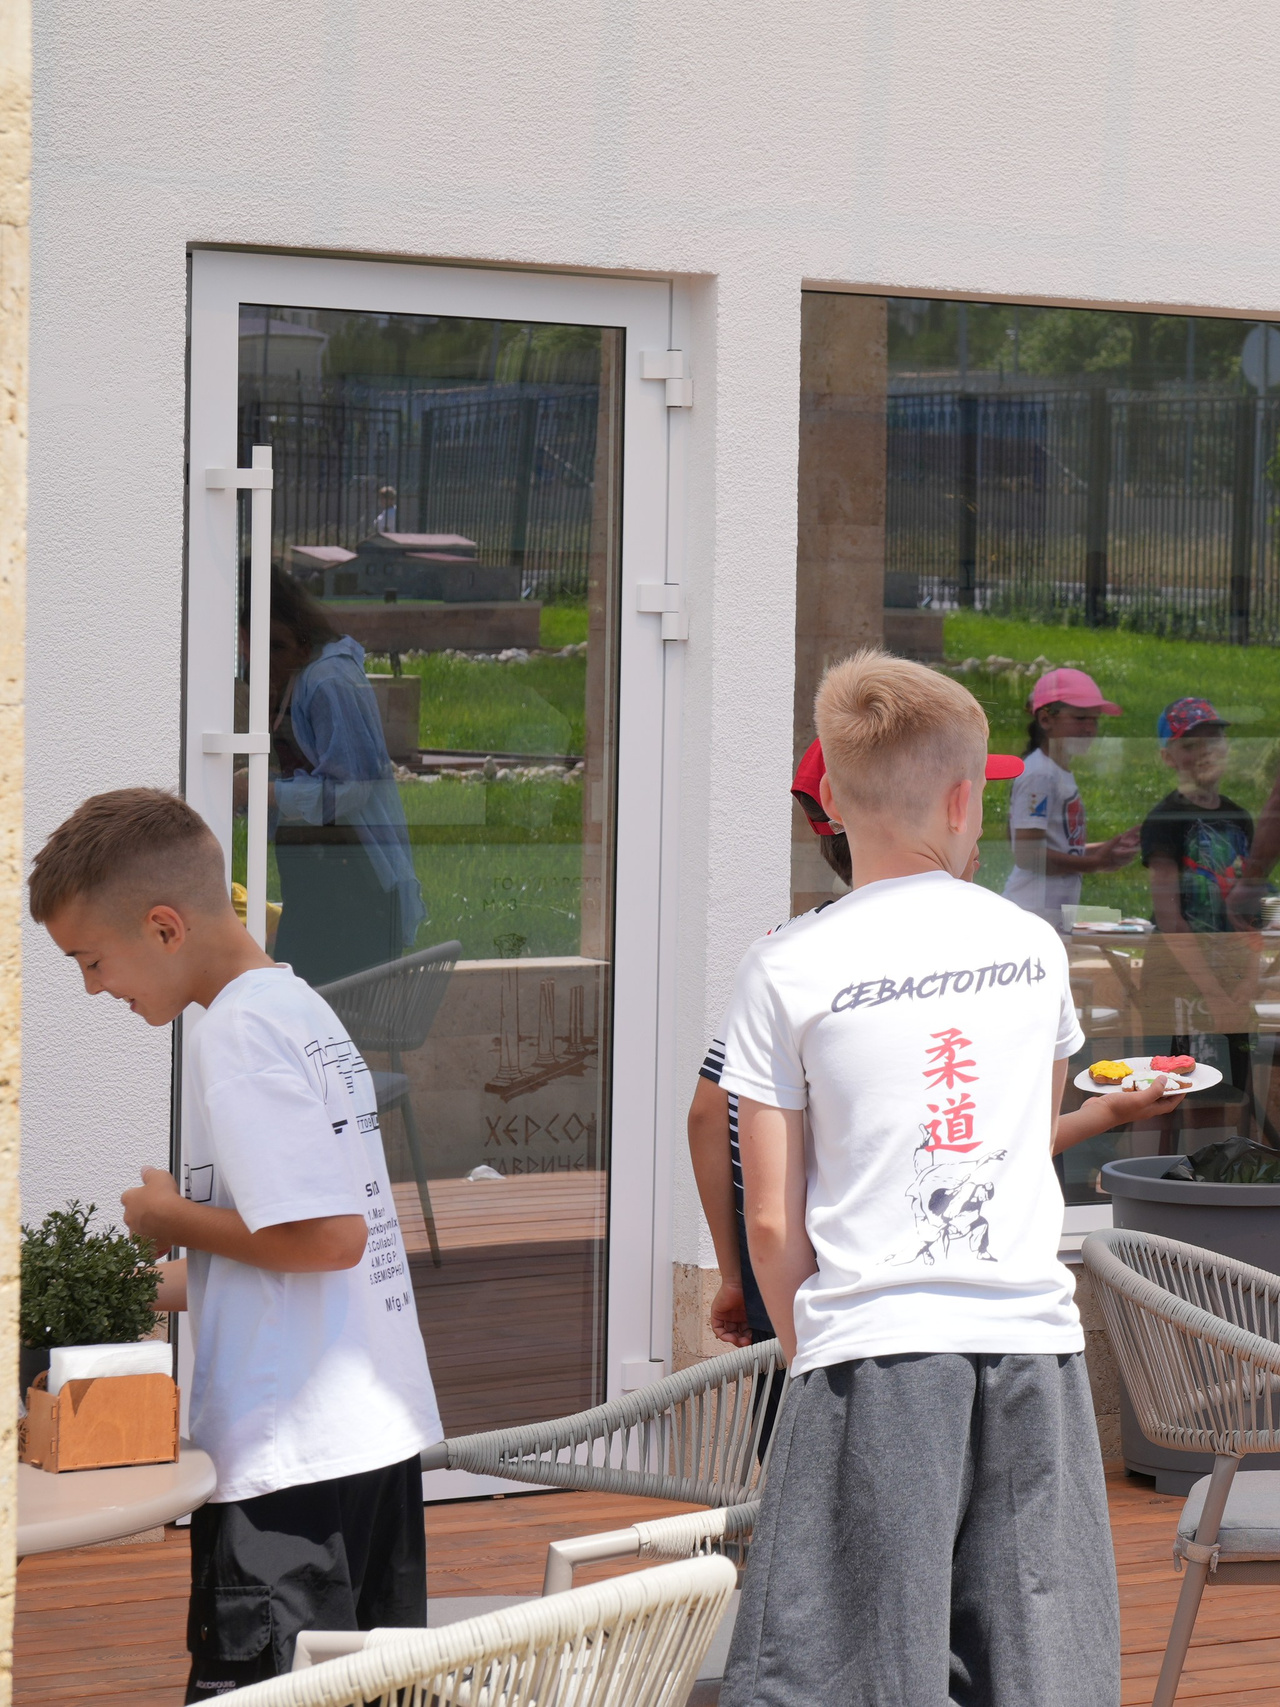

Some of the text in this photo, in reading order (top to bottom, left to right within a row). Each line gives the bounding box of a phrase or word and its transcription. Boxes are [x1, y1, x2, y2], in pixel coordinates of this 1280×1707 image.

[831, 956, 1046, 1013] СЕВАСТОПОЛЬ
[922, 1027, 984, 1154] 柔道
[484, 1112, 588, 1147] ХЕРСО
